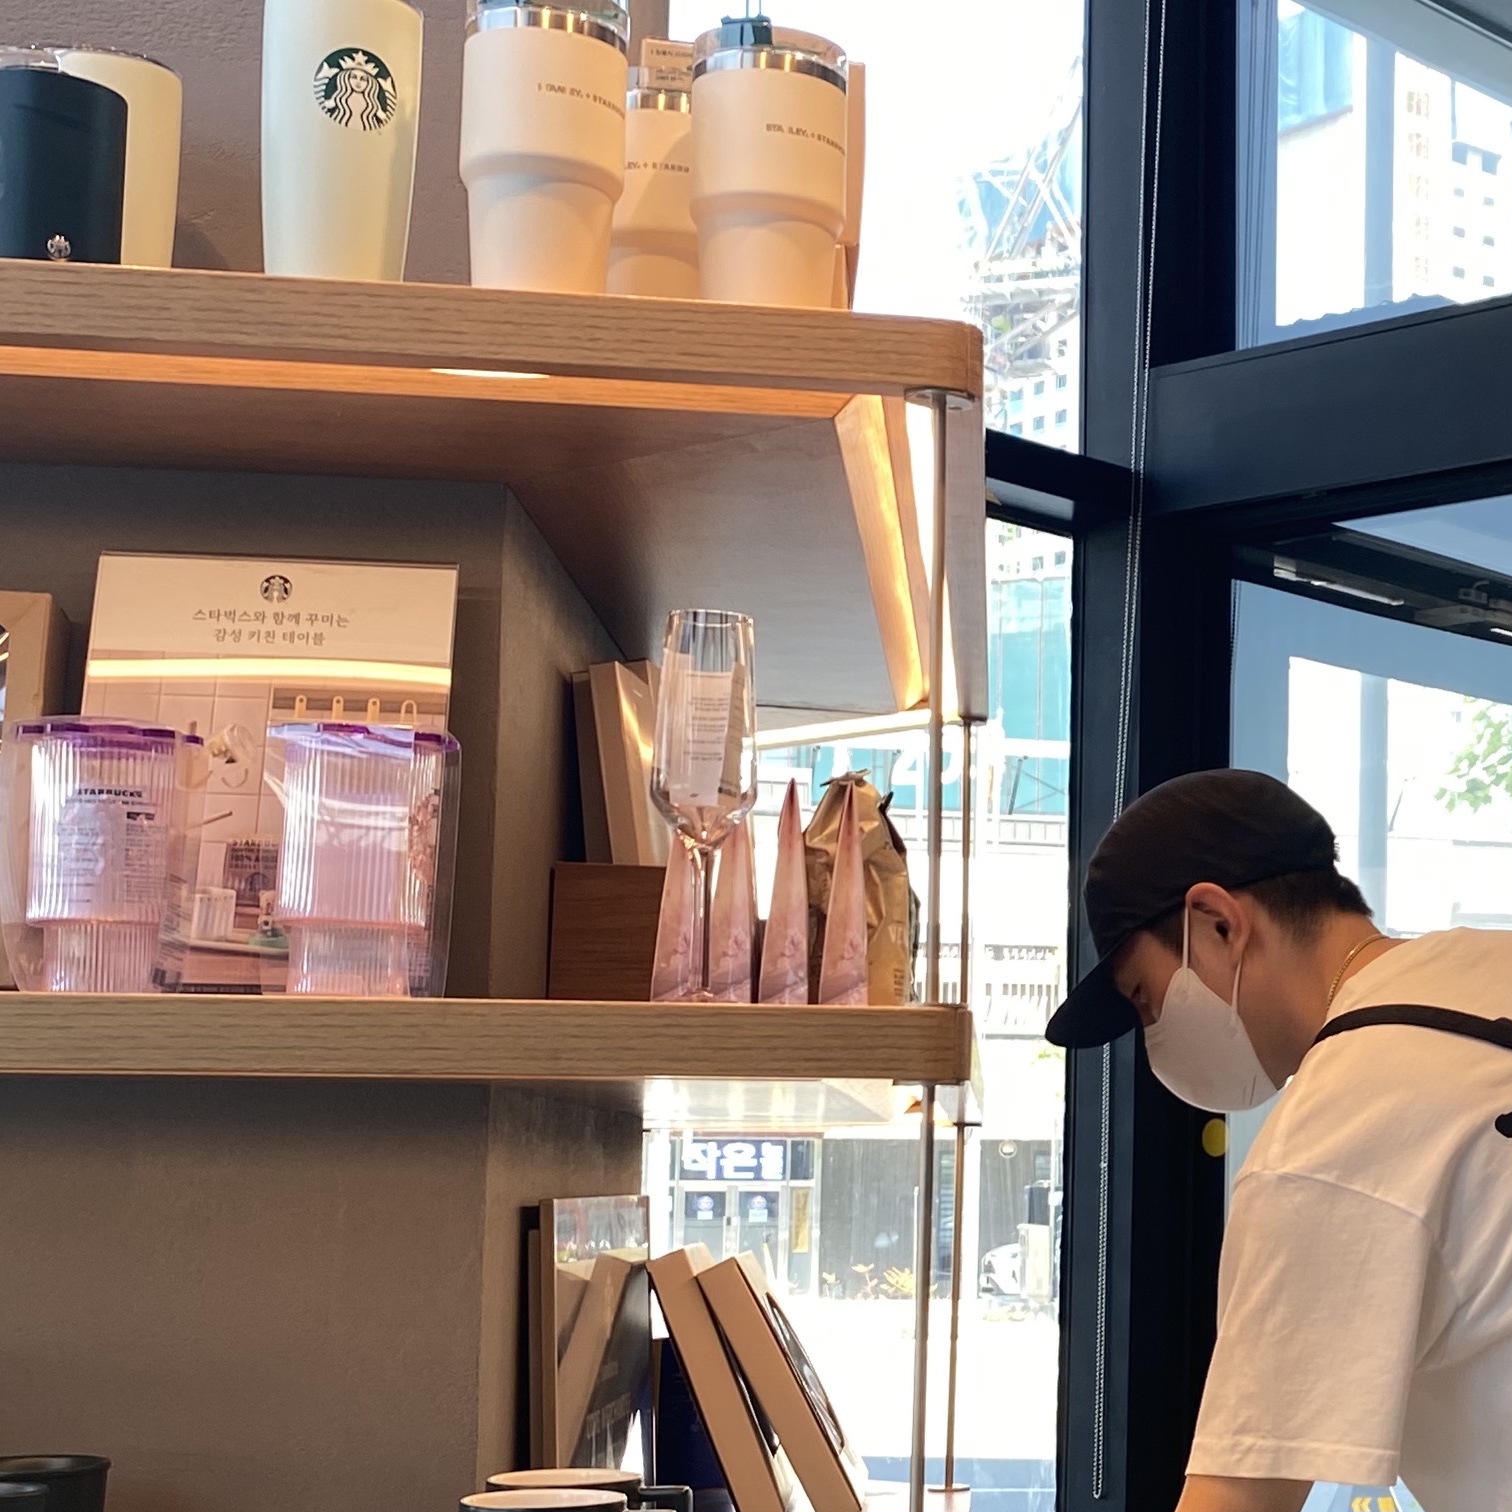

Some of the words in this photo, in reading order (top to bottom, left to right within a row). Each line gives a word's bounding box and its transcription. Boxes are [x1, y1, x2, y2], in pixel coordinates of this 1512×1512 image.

[191, 608, 266, 625] 스타벅스와
[272, 609, 301, 627] 함께
[304, 611, 350, 629] 꾸미는
[214, 627, 243, 644] 감성
[247, 628, 276, 645] 키친
[281, 630, 326, 647] 테이블
[681, 1141, 784, 1180] 작은
